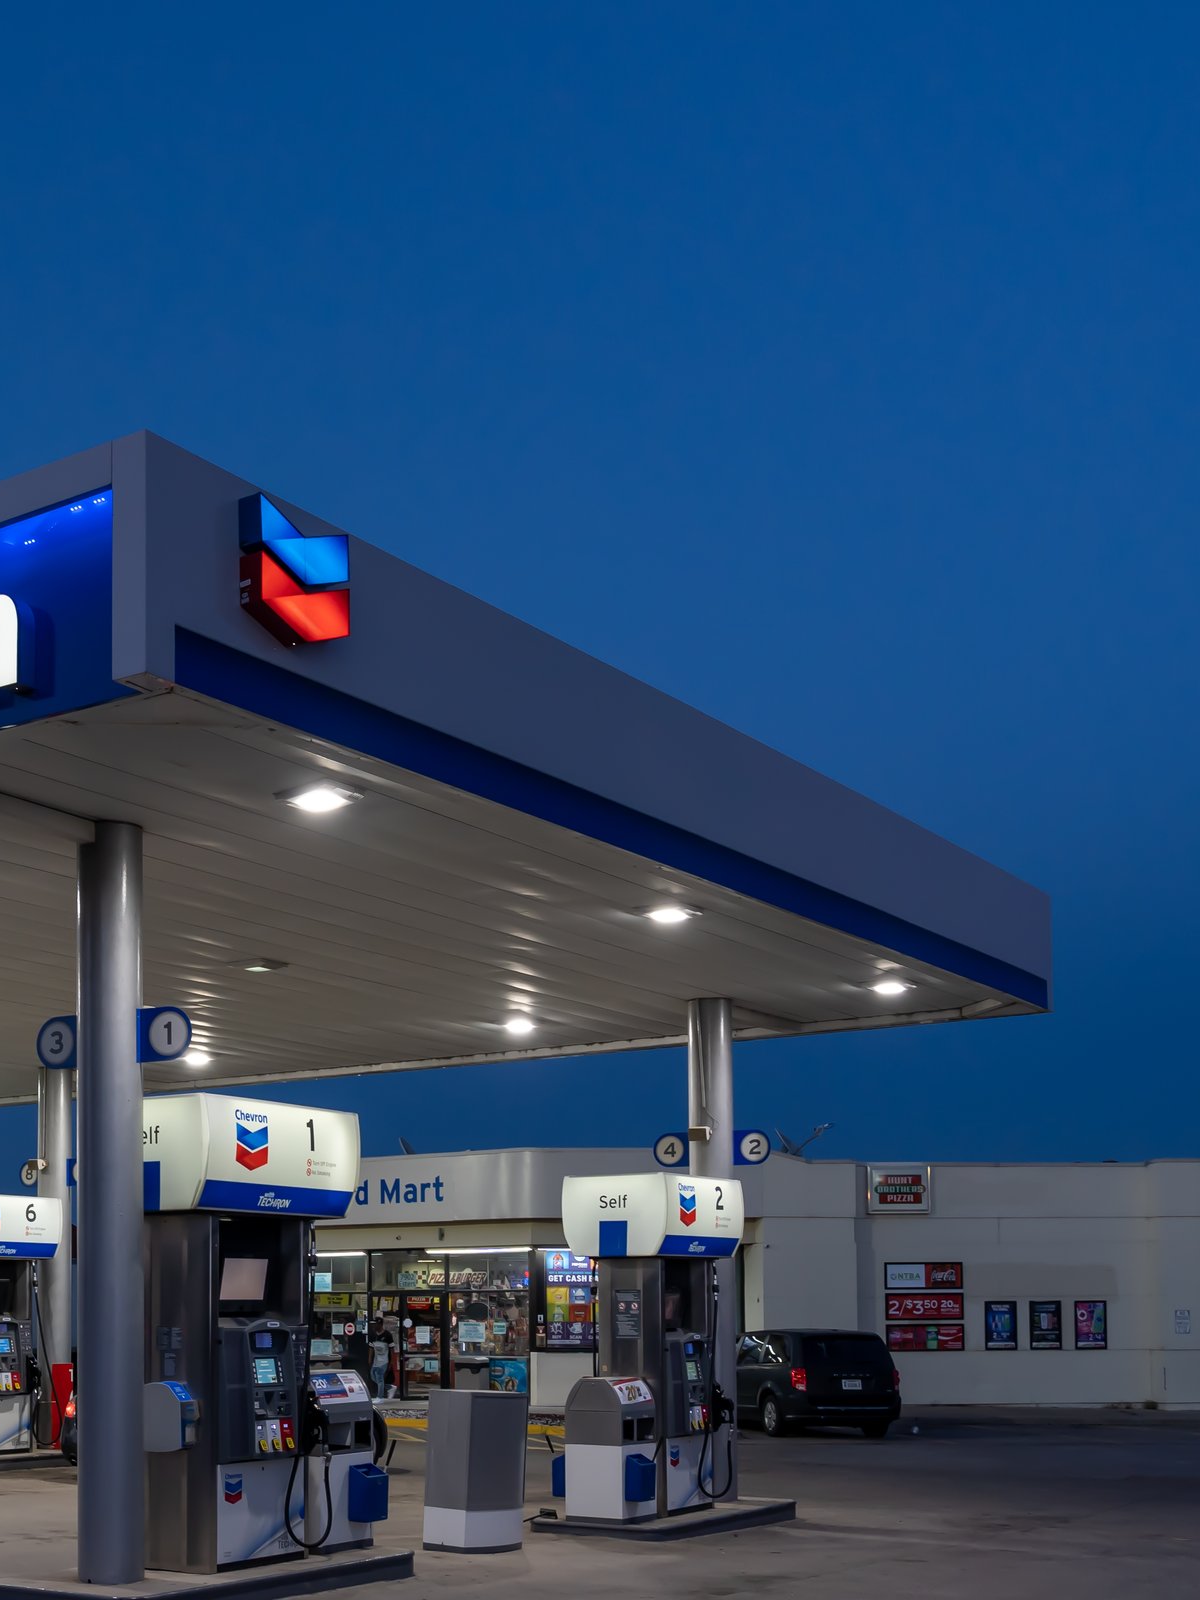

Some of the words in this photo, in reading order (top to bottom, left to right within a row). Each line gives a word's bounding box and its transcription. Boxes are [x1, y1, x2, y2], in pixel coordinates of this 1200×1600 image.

[163, 1021, 172, 1045] 1
[49, 1031, 64, 1054] 3
[235, 1109, 268, 1123] Chevron
[142, 1126, 160, 1144] elf
[306, 1119, 315, 1151] 1
[663, 1143, 677, 1158] 4
[749, 1139, 761, 1154] 2
[26, 1169, 33, 1180] 8
[380, 1175, 444, 1204] Mart
[678, 1183, 695, 1192] Chevron
[257, 1196, 291, 1209] TECHRON
[599, 1195, 628, 1209] Self
[715, 1186, 724, 1210] 2
[26, 1204, 37, 1222] 6
[429, 1272, 445, 1284] PIZZ
